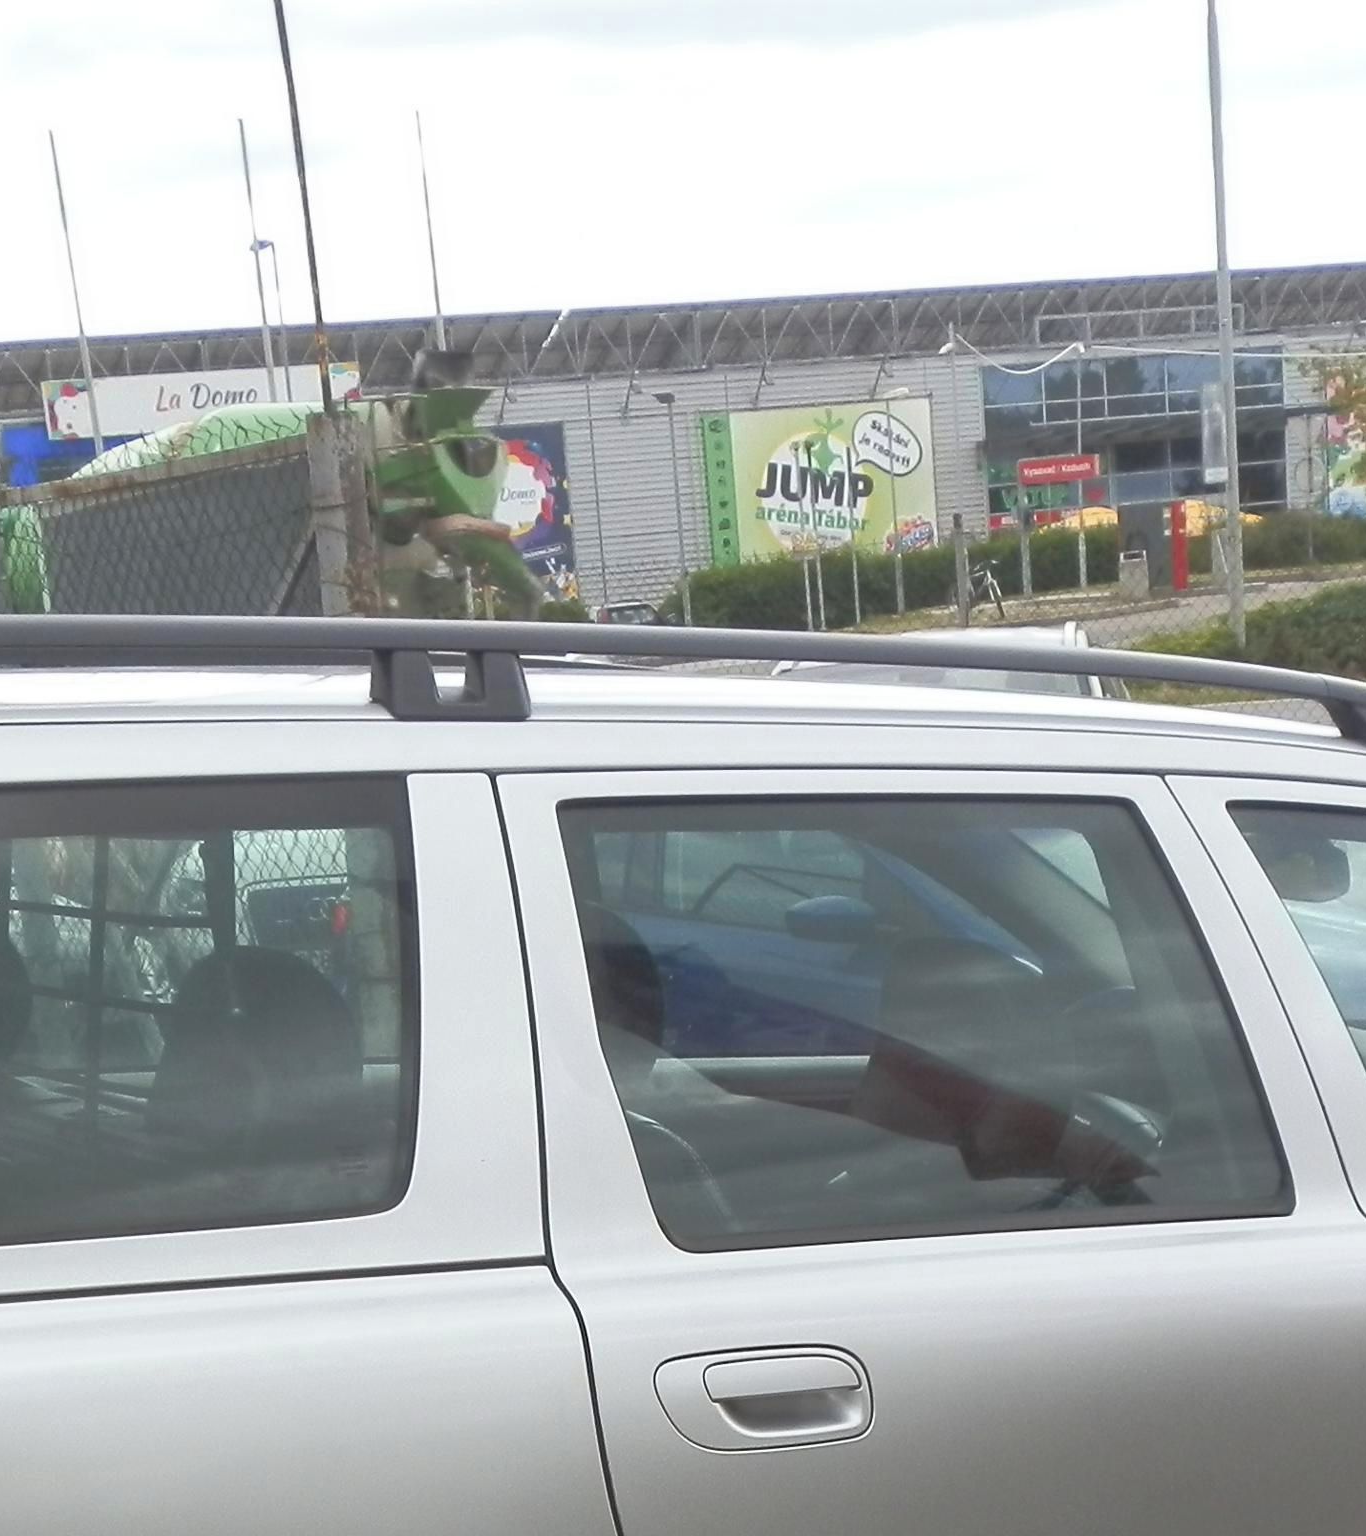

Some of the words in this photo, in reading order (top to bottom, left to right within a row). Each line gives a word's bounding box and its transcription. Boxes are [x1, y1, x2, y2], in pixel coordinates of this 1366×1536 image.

[156, 385, 182, 412] La
[190, 383, 258, 410] Domo
[755, 462, 874, 509] JUMP
[755, 502, 810, 527] aréna
[815, 505, 869, 532] Tábor
